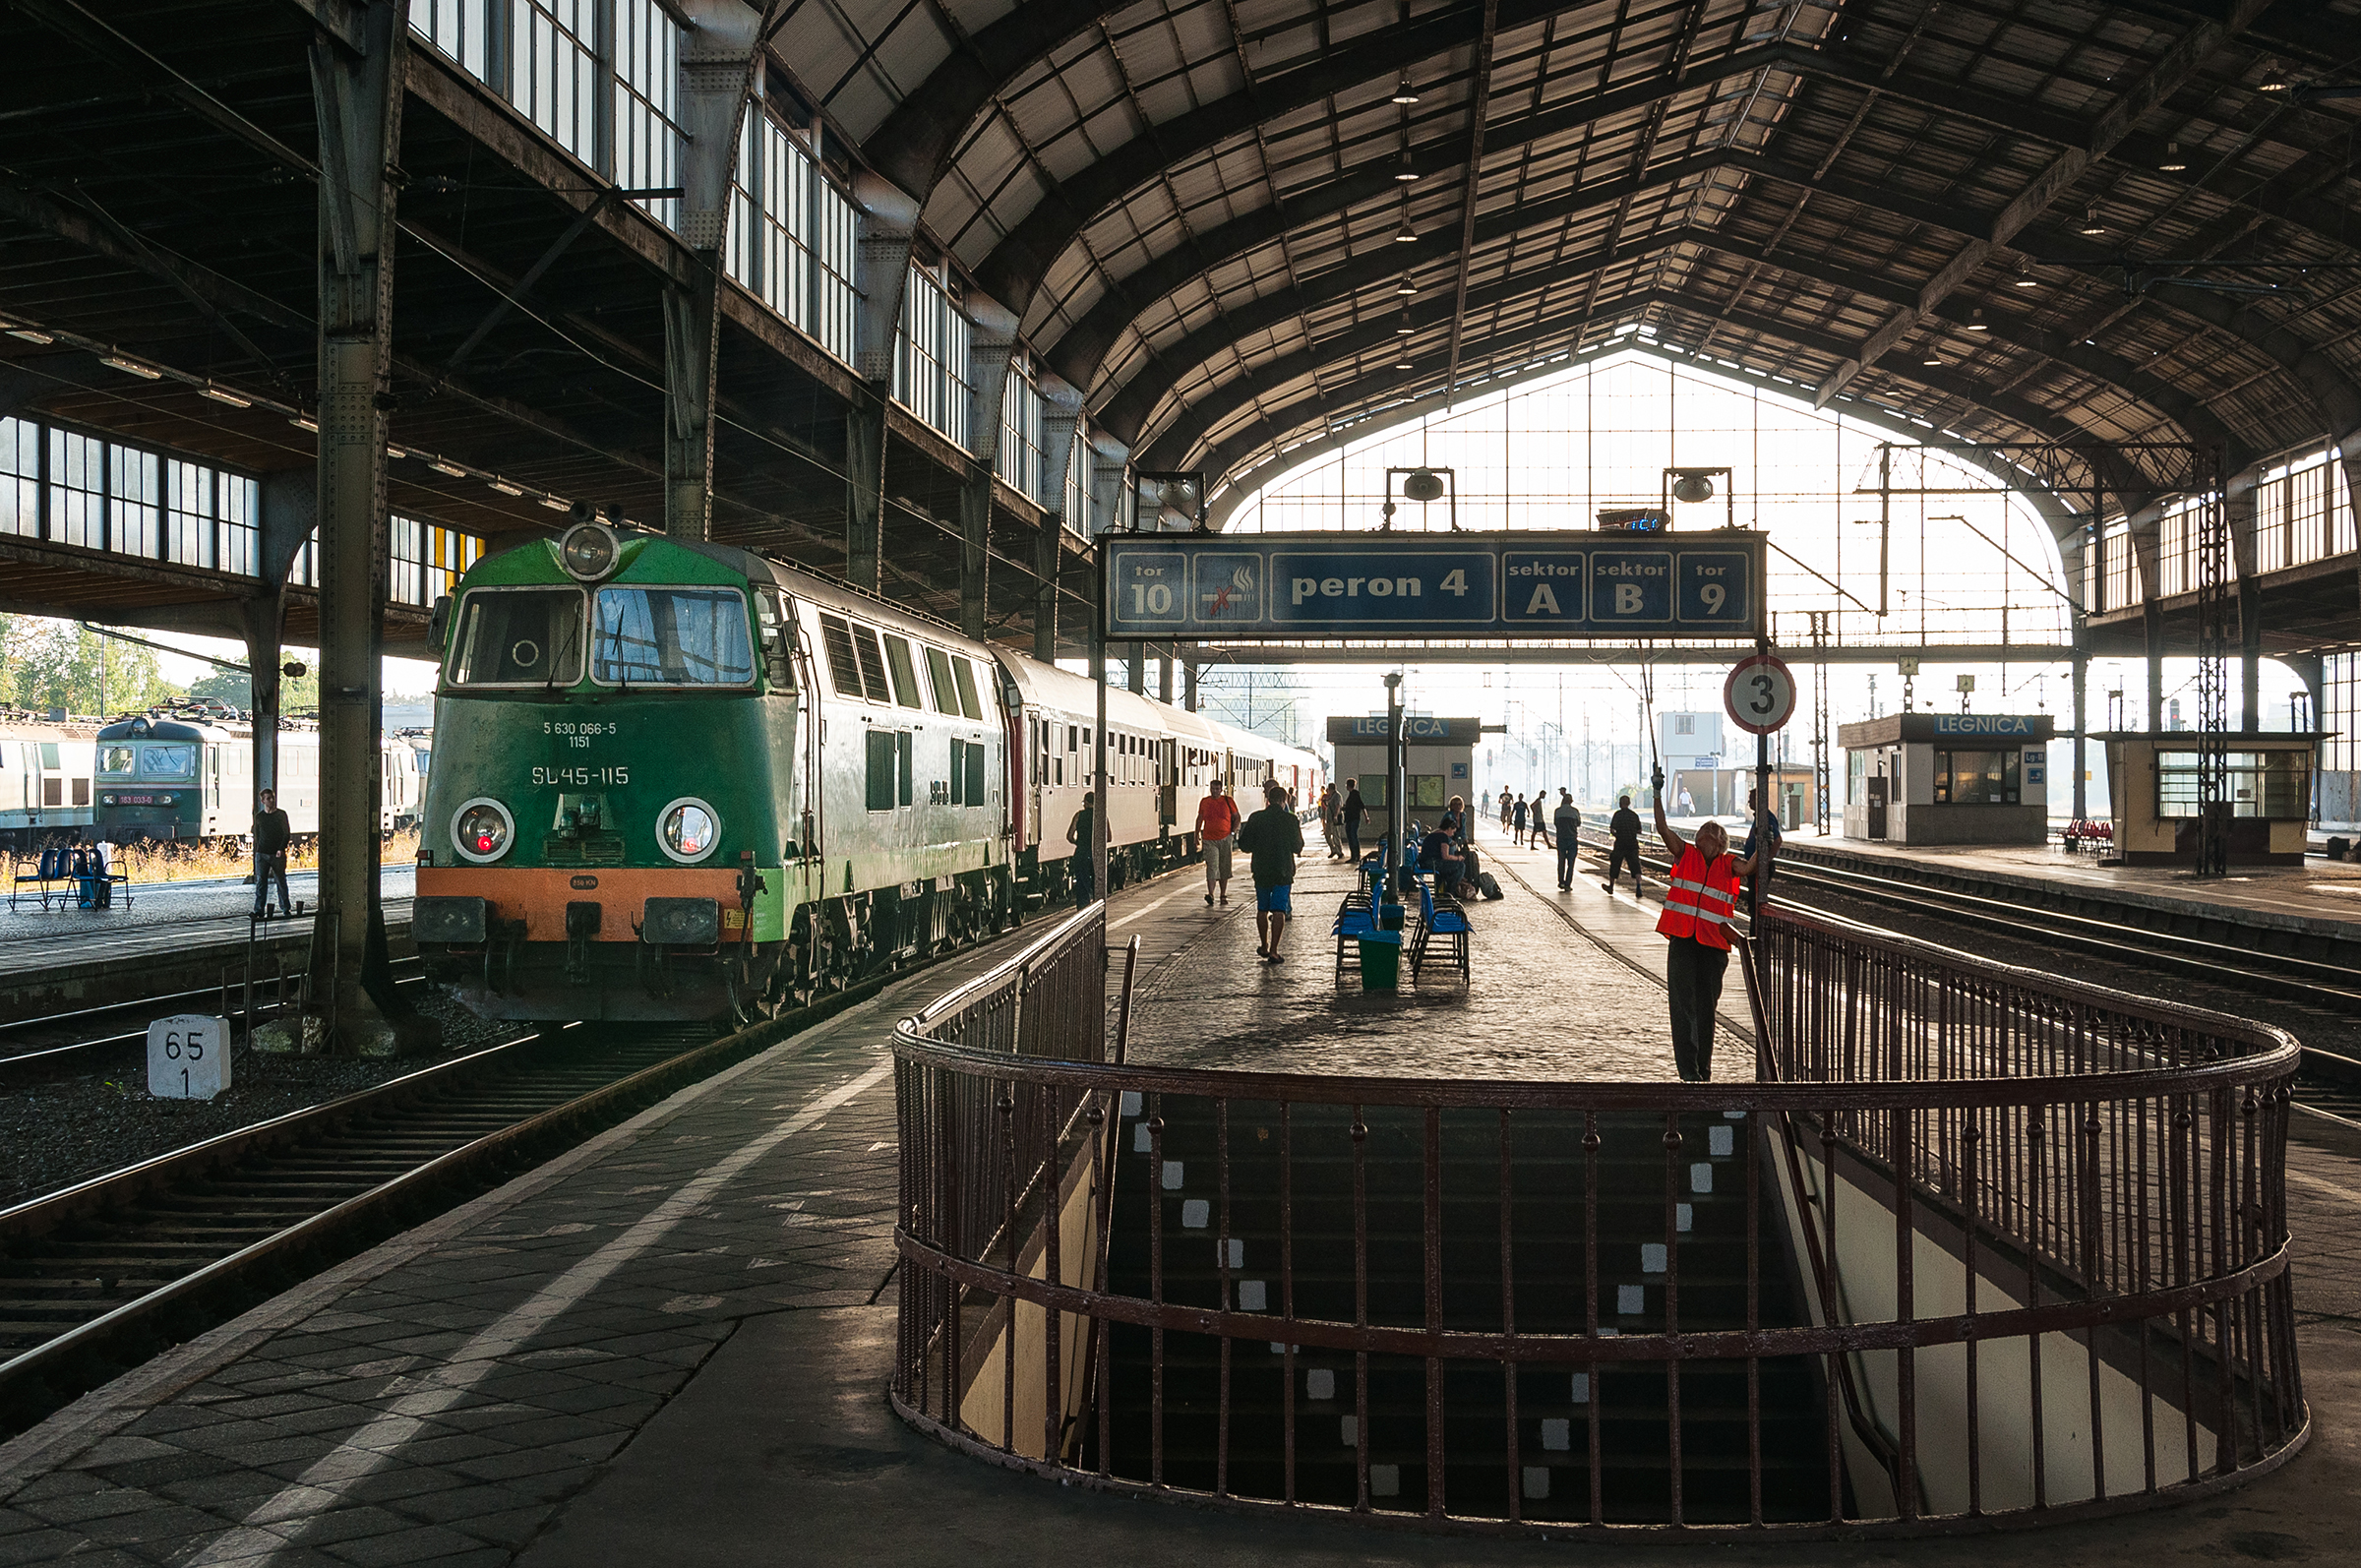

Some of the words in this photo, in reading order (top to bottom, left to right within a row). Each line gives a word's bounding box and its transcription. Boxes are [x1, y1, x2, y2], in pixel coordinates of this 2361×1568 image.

[1135, 566, 1165, 577] tor
[1509, 561, 1579, 576] sektor
[1597, 561, 1666, 576] sektor
[1695, 564, 1726, 576] tor
[1292, 577, 1422, 605] peron
[1439, 569, 1469, 597] 4
[1131, 583, 1173, 615] 10
[1526, 583, 1562, 615] A
[1614, 583, 1644, 615] B
[1700, 583, 1725, 615] 9
[1750, 675, 1775, 714] 3
[543, 722, 551, 735] 5
[554, 722, 575, 735] 630
[579, 722, 617, 735] 066-5
[1358, 719, 1444, 735] LEGICA
[1939, 717, 2028, 733] LEGNICA
[569, 736, 589, 748] 1151
[166, 1032, 204, 1061] 65
[181, 1067, 189, 1095] 1
